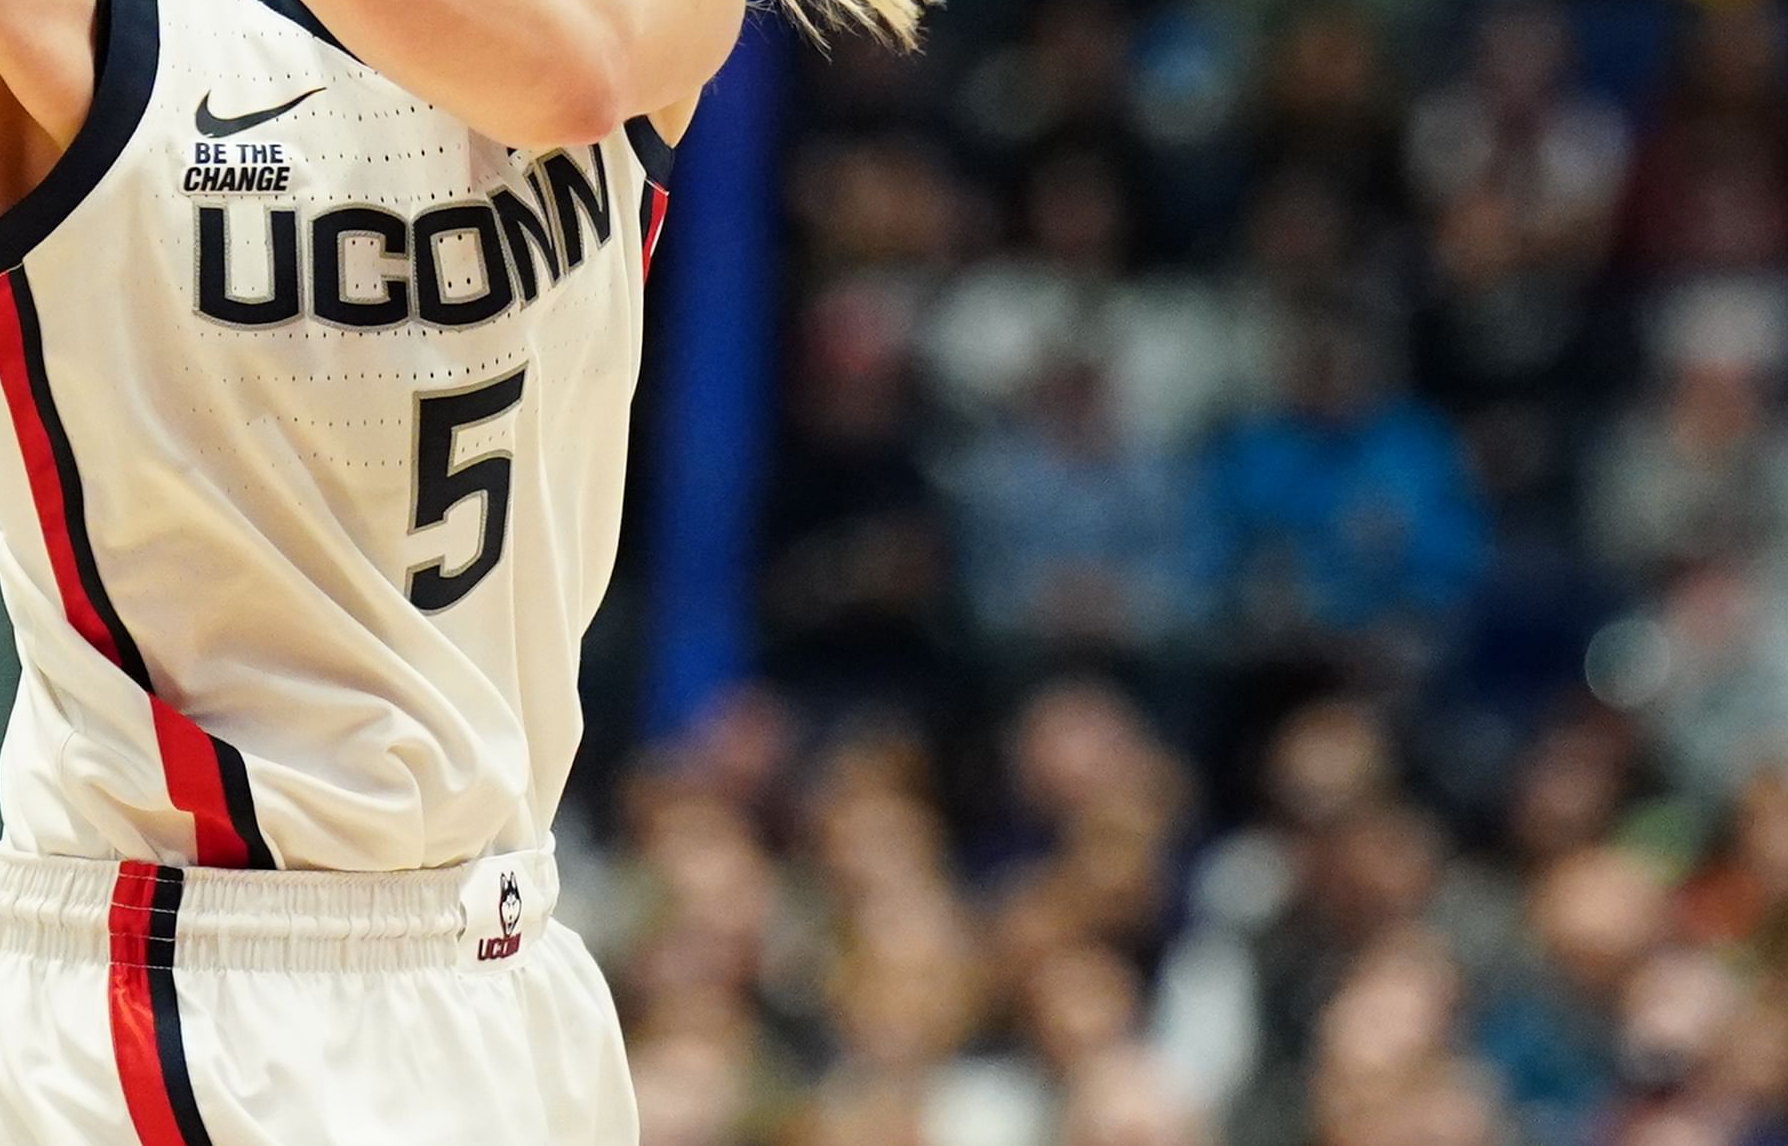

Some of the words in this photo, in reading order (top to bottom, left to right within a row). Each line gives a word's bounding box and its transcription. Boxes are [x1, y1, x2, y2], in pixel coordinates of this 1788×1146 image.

[183, 166, 291, 192] CHANGE
[195, 142, 227, 164] BE
[236, 144, 284, 164] THE
[193, 143, 612, 332] UCONN
[406, 360, 529, 614] 5
